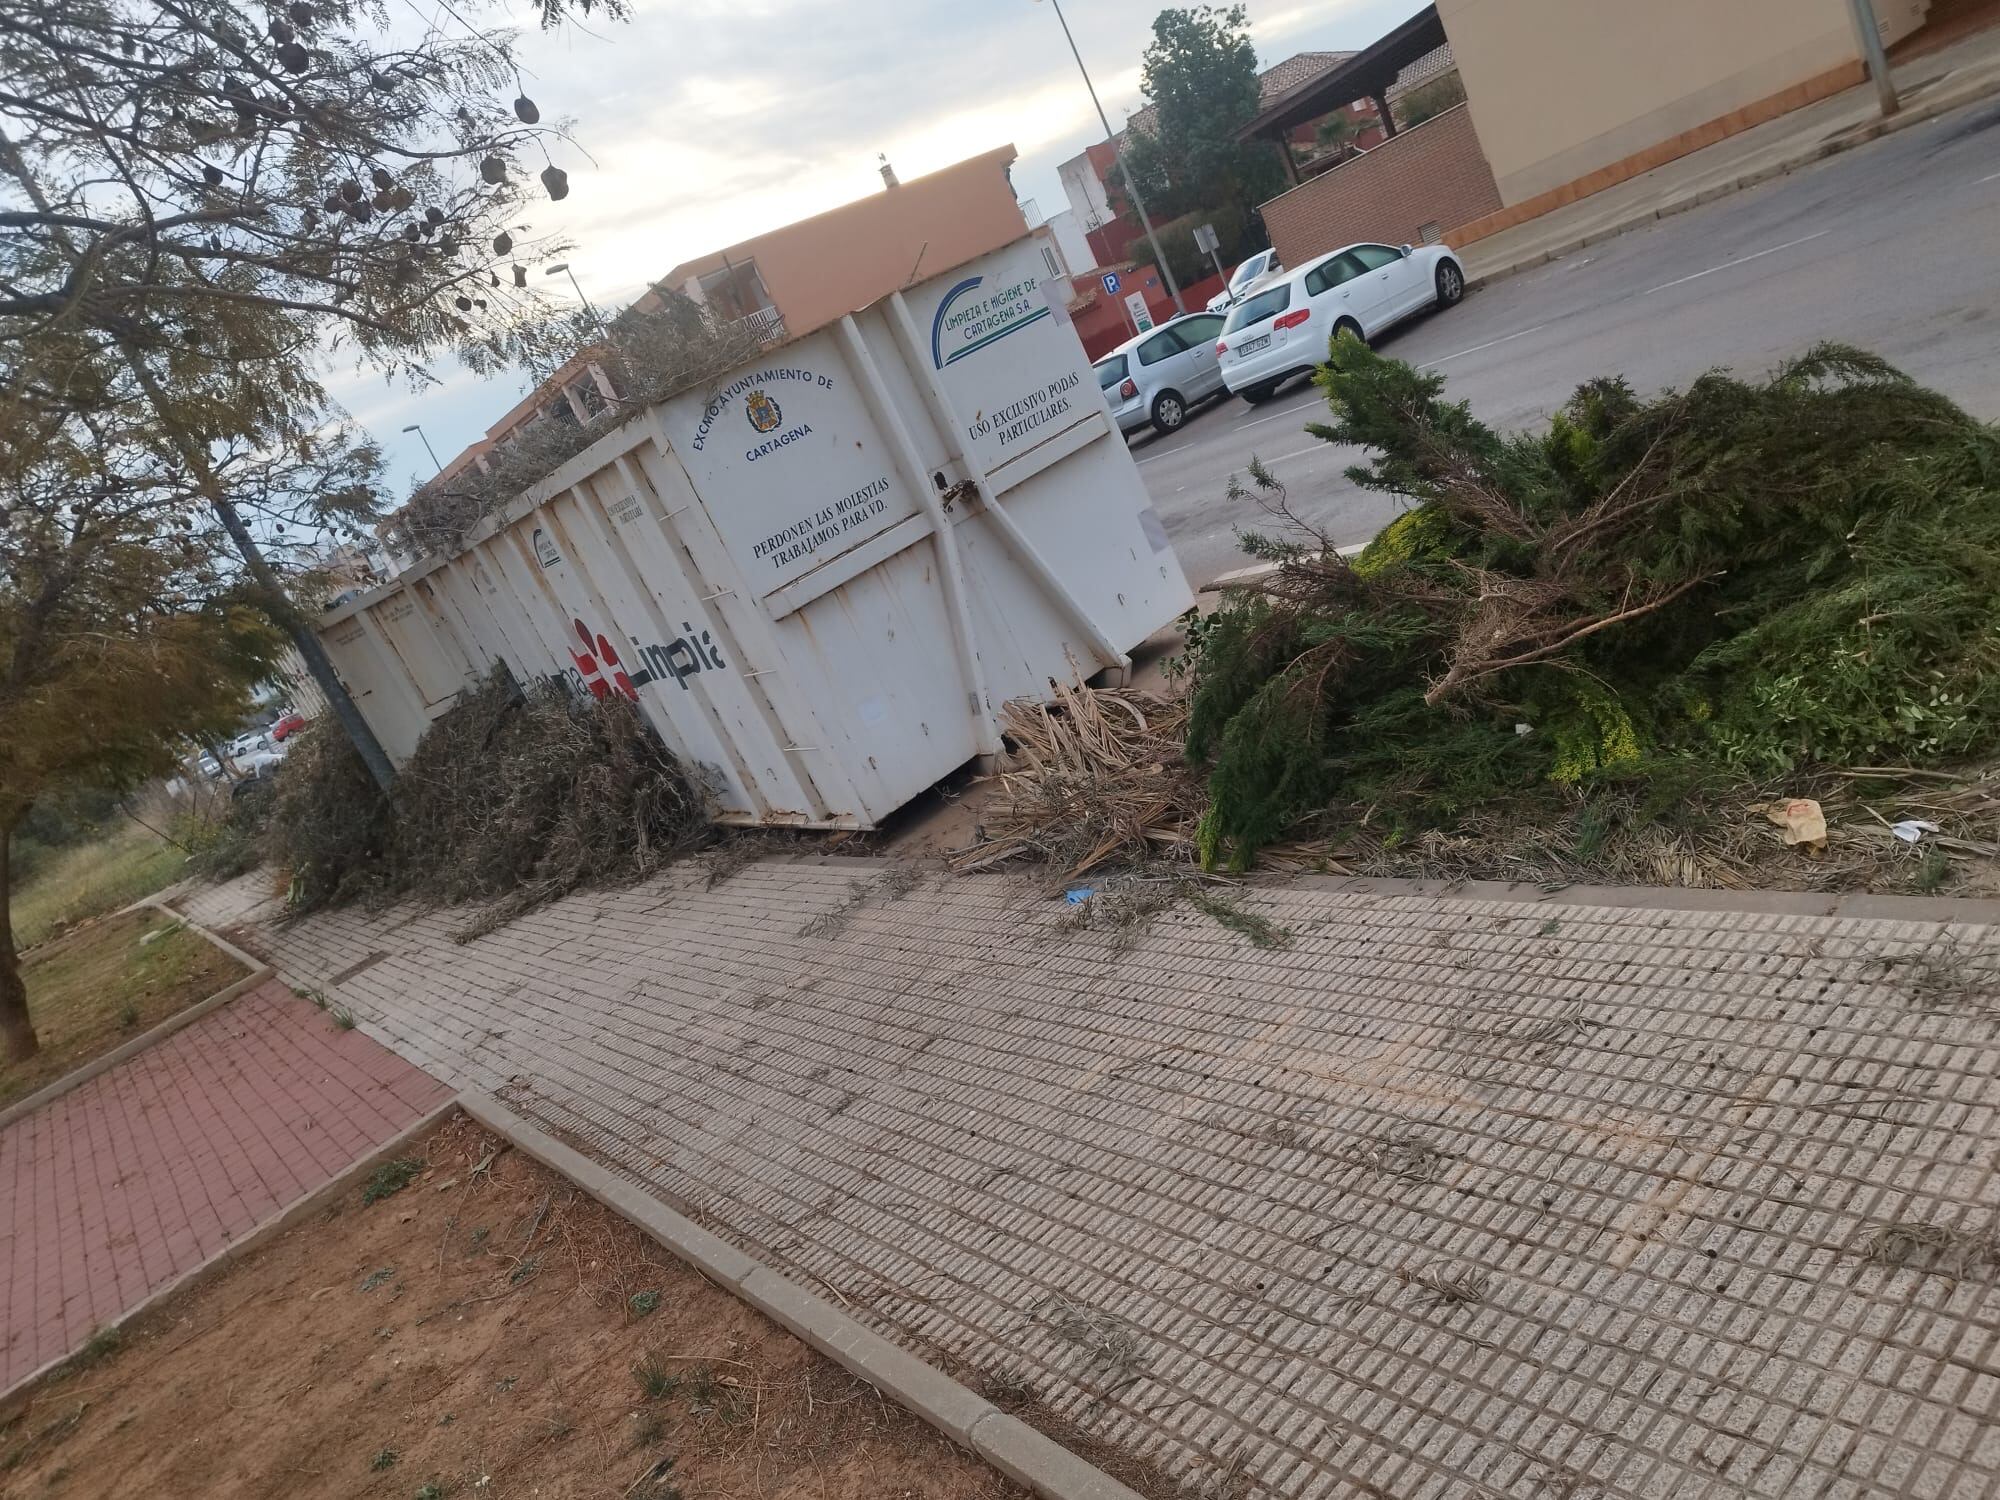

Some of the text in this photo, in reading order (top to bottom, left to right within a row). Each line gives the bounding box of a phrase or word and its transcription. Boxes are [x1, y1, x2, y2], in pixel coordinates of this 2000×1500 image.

[944, 278, 1037, 331] LIMPIEZA E HIGIENE DE
[1106, 275, 1115, 292] P
[964, 308, 1016, 340] CARTAGENA
[817, 374, 833, 390] DE
[968, 371, 1080, 441] USO EXCLUSIVO PODAS
[746, 423, 813, 462] CARTAGENA
[999, 396, 1072, 446] PARTICULARES.
[753, 477, 890, 559] PERDONEN LAS MOLESTIAS
[771, 499, 888, 569] TRABAJAMOS PARA VD.
